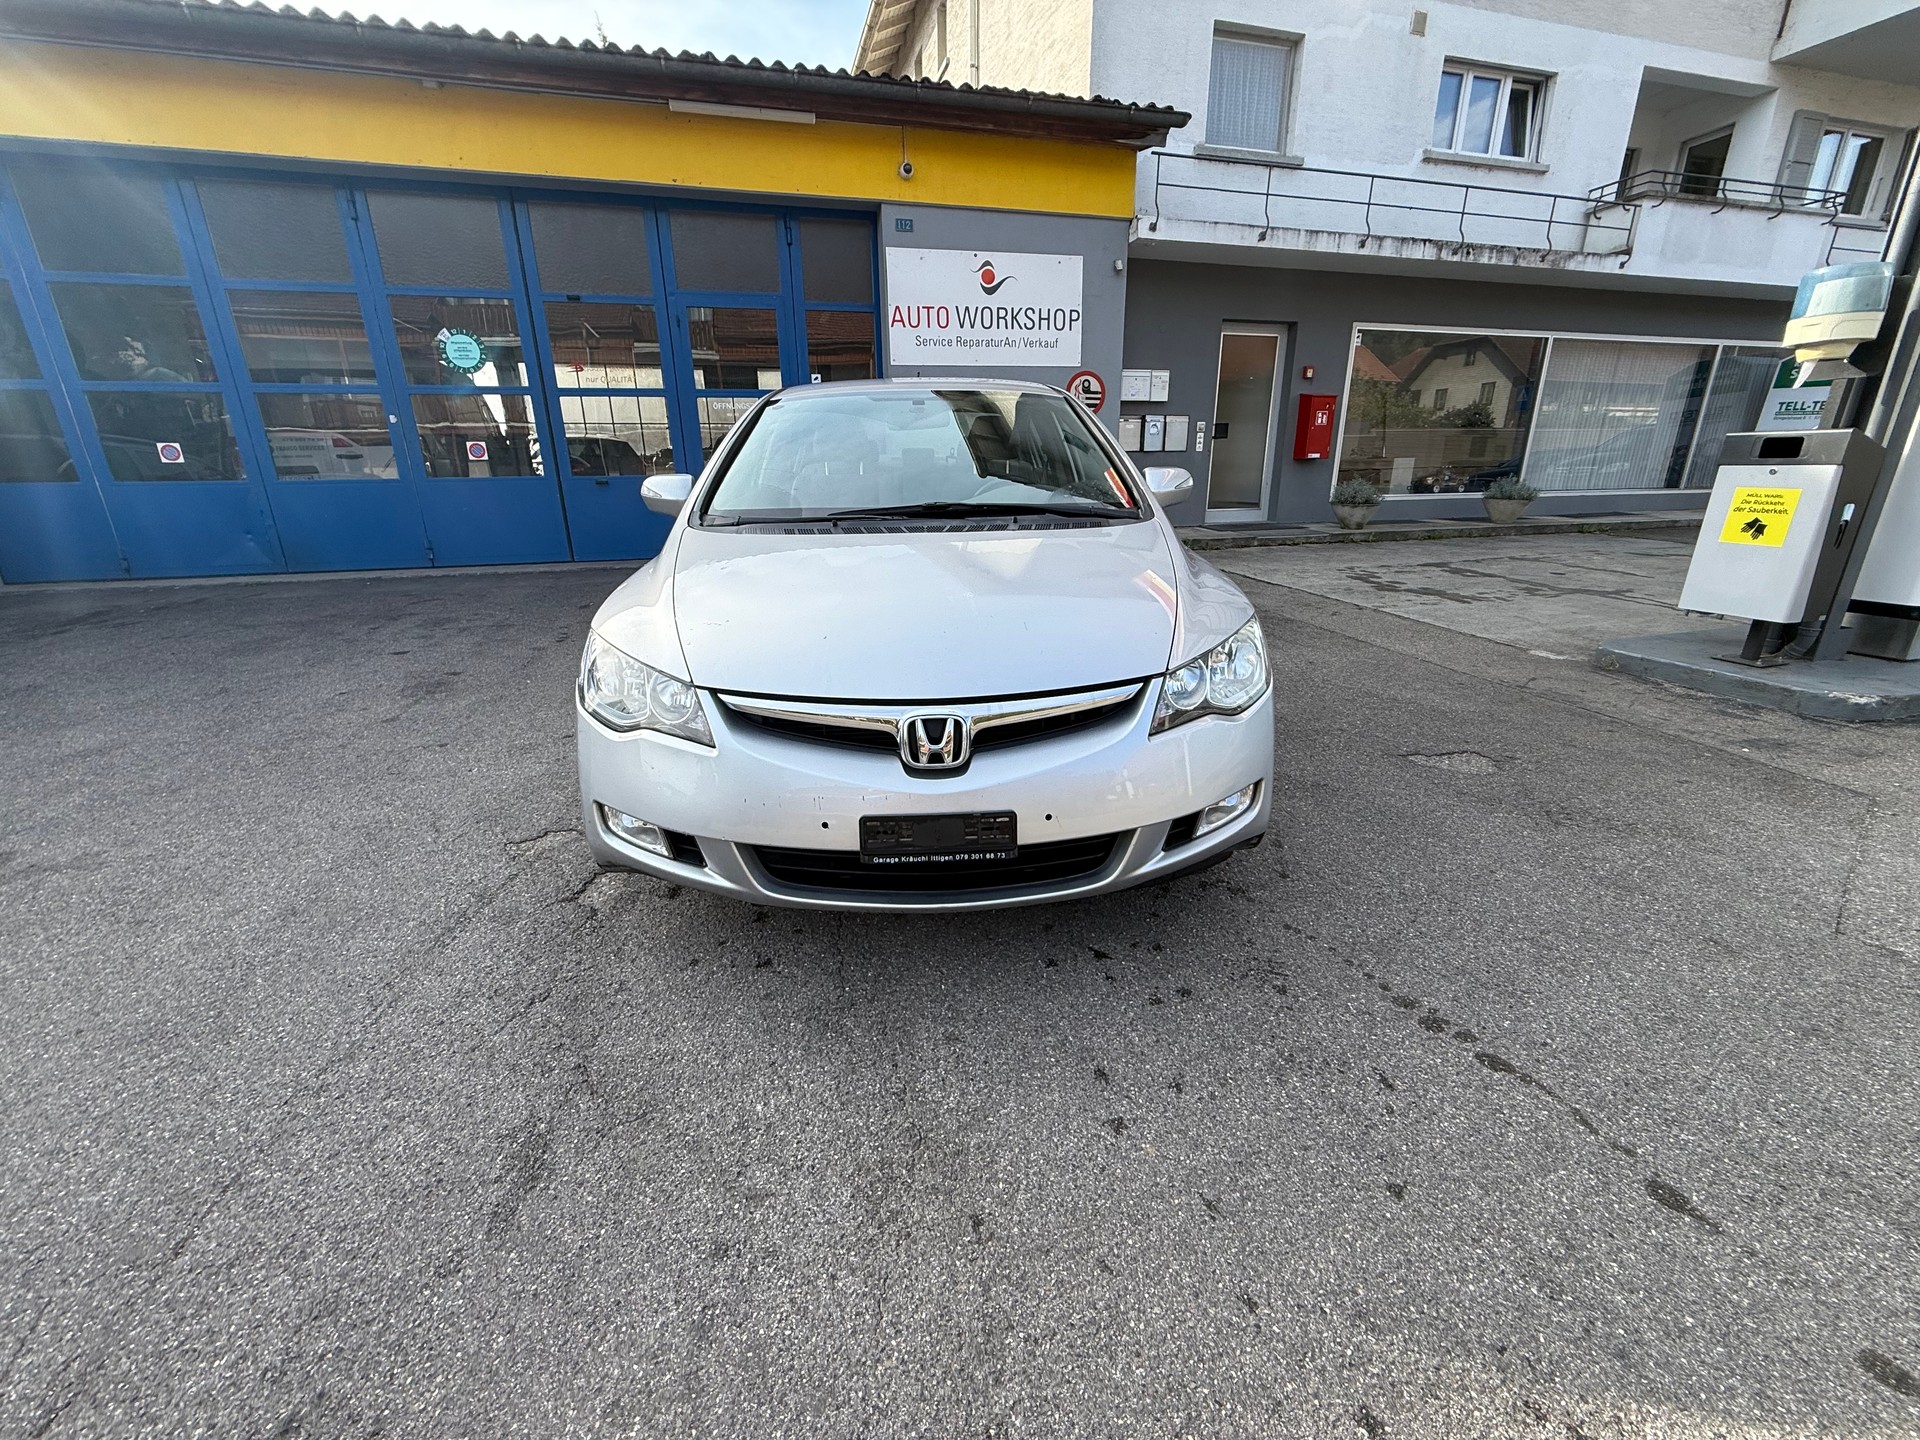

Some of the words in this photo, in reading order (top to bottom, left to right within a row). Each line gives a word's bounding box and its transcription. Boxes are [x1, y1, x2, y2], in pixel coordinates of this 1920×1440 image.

[897, 220, 911, 230] 112
[890, 305, 950, 329] AUTO
[955, 305, 1081, 332] WORKSHOP
[915, 335, 953, 347] Service
[1778, 400, 1827, 411] TELL-TE
[873, 856, 899, 864] Garage
